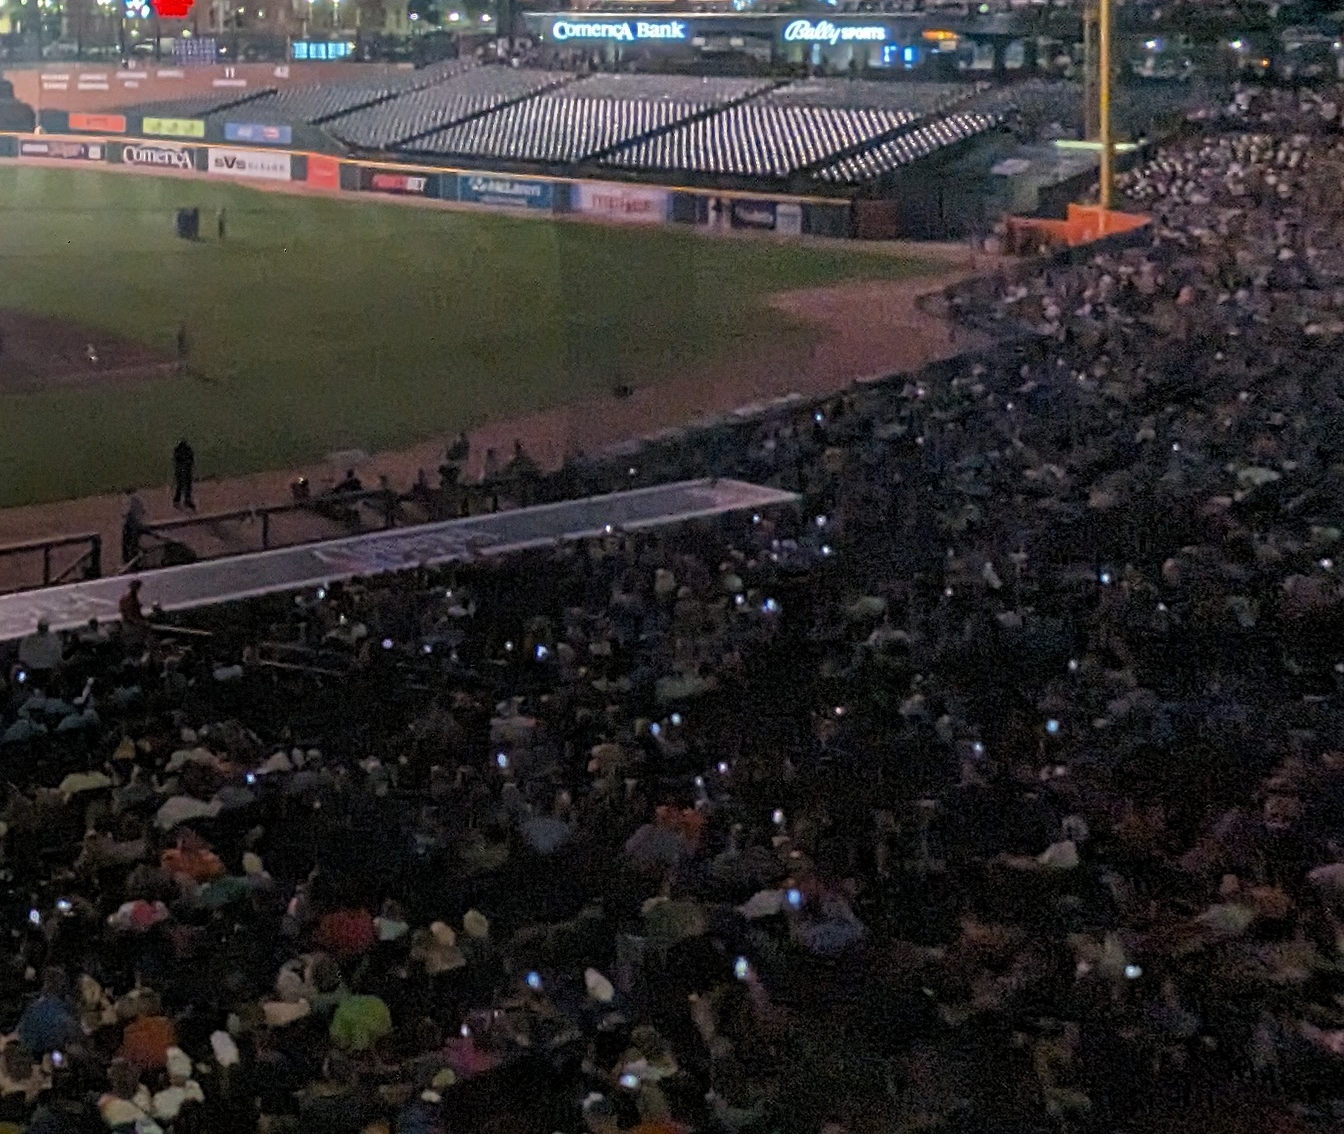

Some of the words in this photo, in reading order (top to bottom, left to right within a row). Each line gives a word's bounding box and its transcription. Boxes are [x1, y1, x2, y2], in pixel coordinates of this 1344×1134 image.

[637, 22, 685, 39] Bank
[785, 20, 841, 42] Bally
[841, 27, 885, 40] SPORTS
